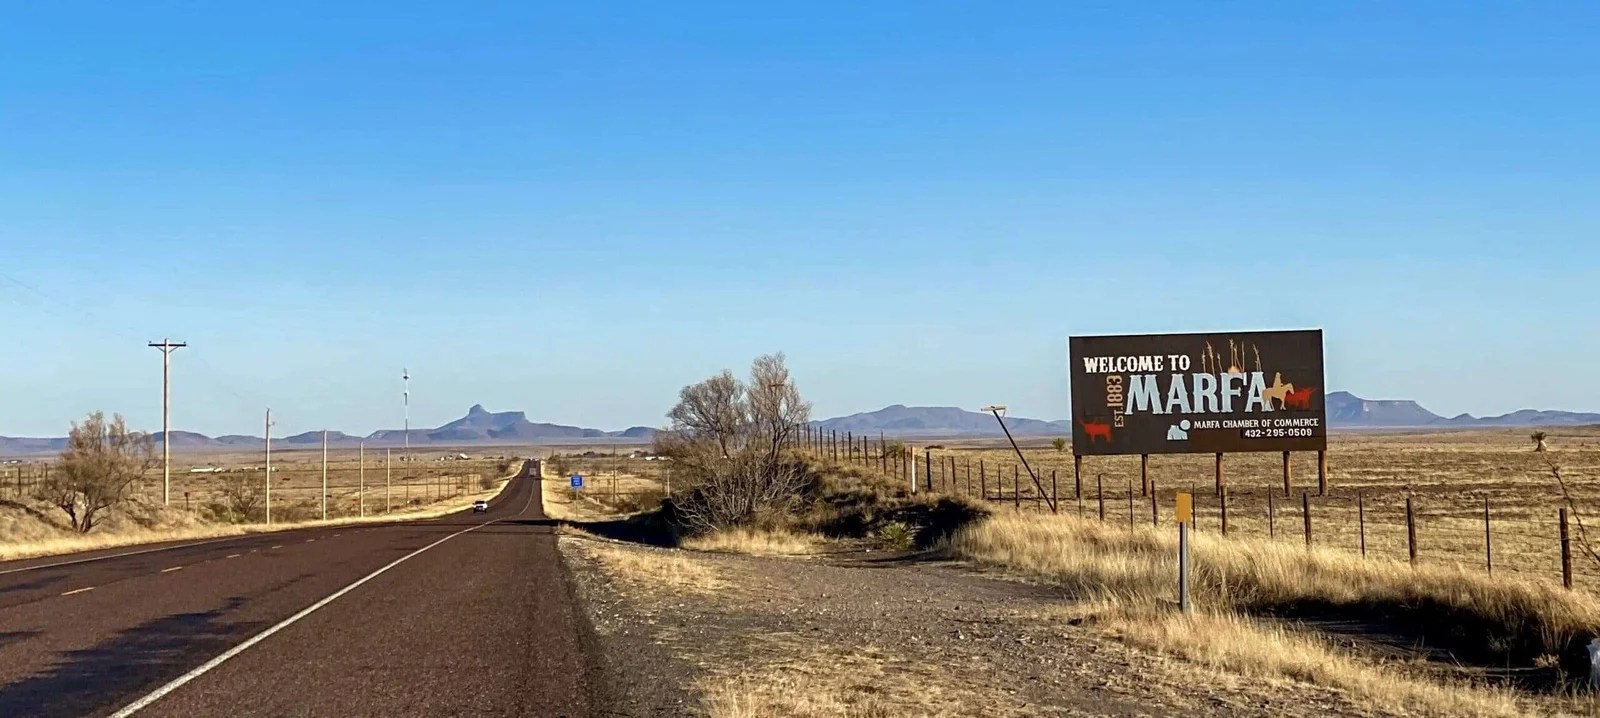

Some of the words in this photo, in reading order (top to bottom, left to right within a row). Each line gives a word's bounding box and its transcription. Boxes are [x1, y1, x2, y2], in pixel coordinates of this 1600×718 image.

[1083, 356, 1163, 374] WELCOME
[1168, 354, 1191, 371] TO
[1125, 371, 1273, 415] MARFA
[1193, 420, 1221, 429] MARFA
[1222, 419, 1260, 429] CHAMBER
[1261, 419, 1272, 428] OF
[1274, 418, 1319, 428] COMMERCE
[1244, 428, 1313, 438] 432-295-0509
